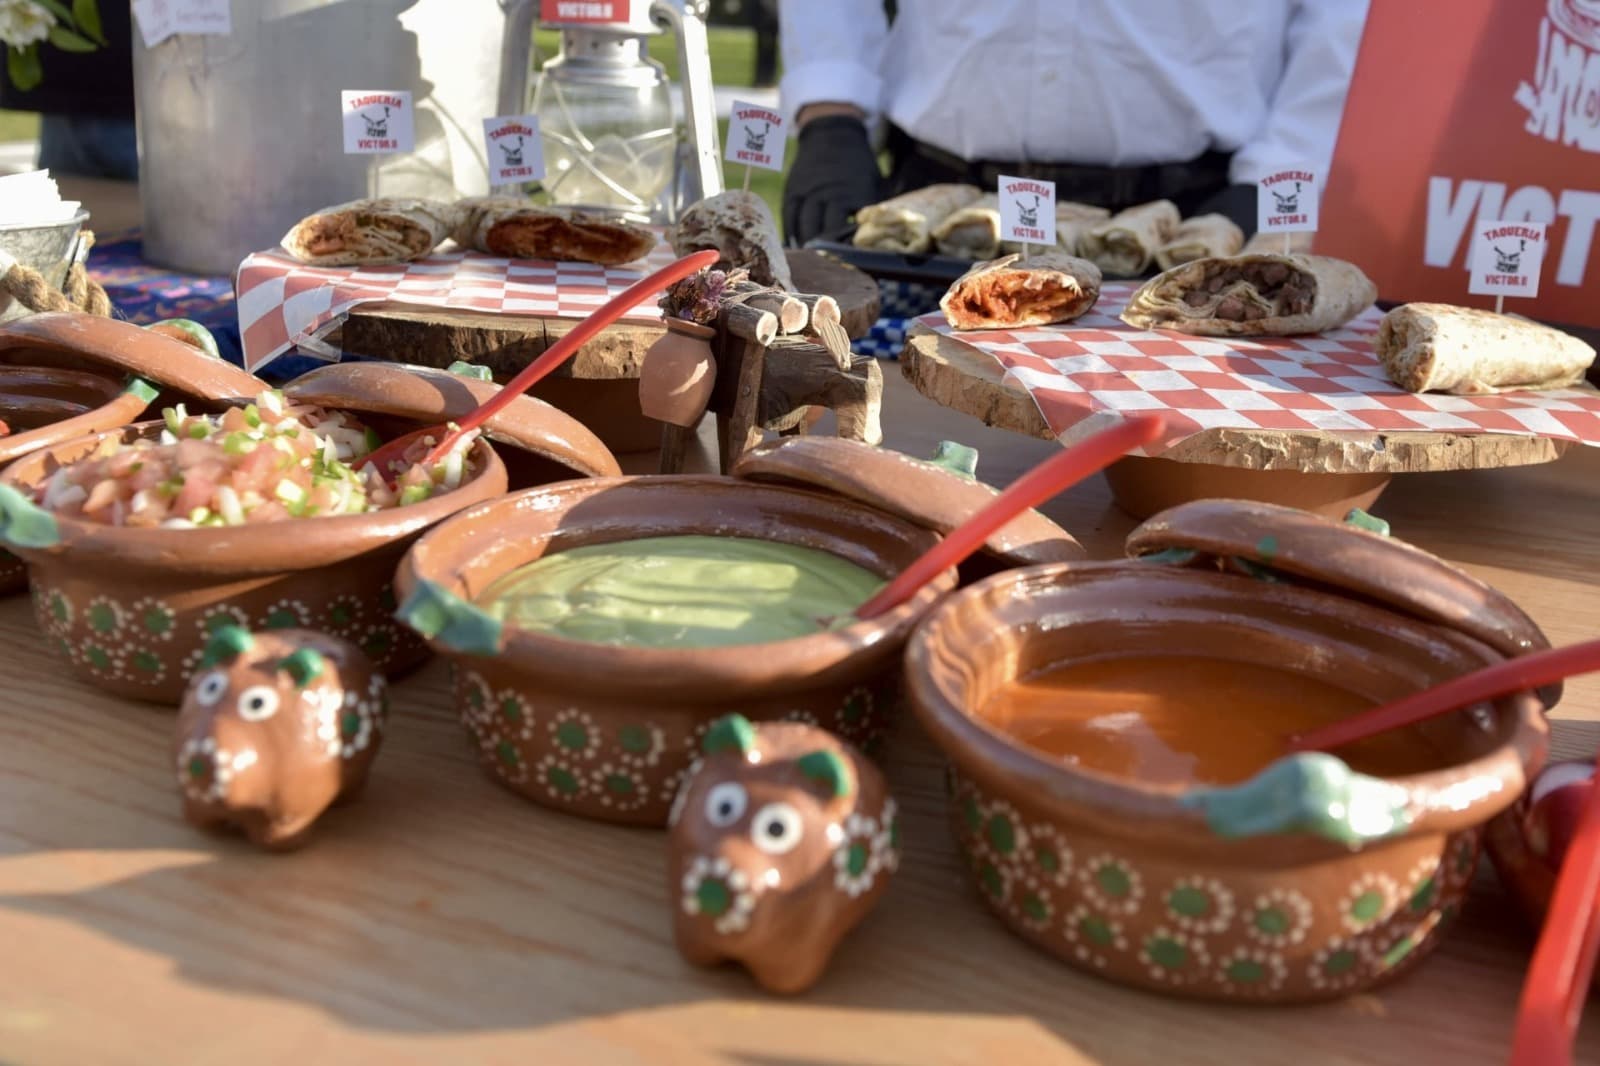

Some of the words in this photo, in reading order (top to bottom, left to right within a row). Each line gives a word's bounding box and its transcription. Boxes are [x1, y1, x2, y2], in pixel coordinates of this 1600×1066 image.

[1261, 171, 1314, 187] TAQUERIA
[1005, 182, 1050, 200] TAQUERIA
[1484, 227, 1541, 242] TAQUERIA
